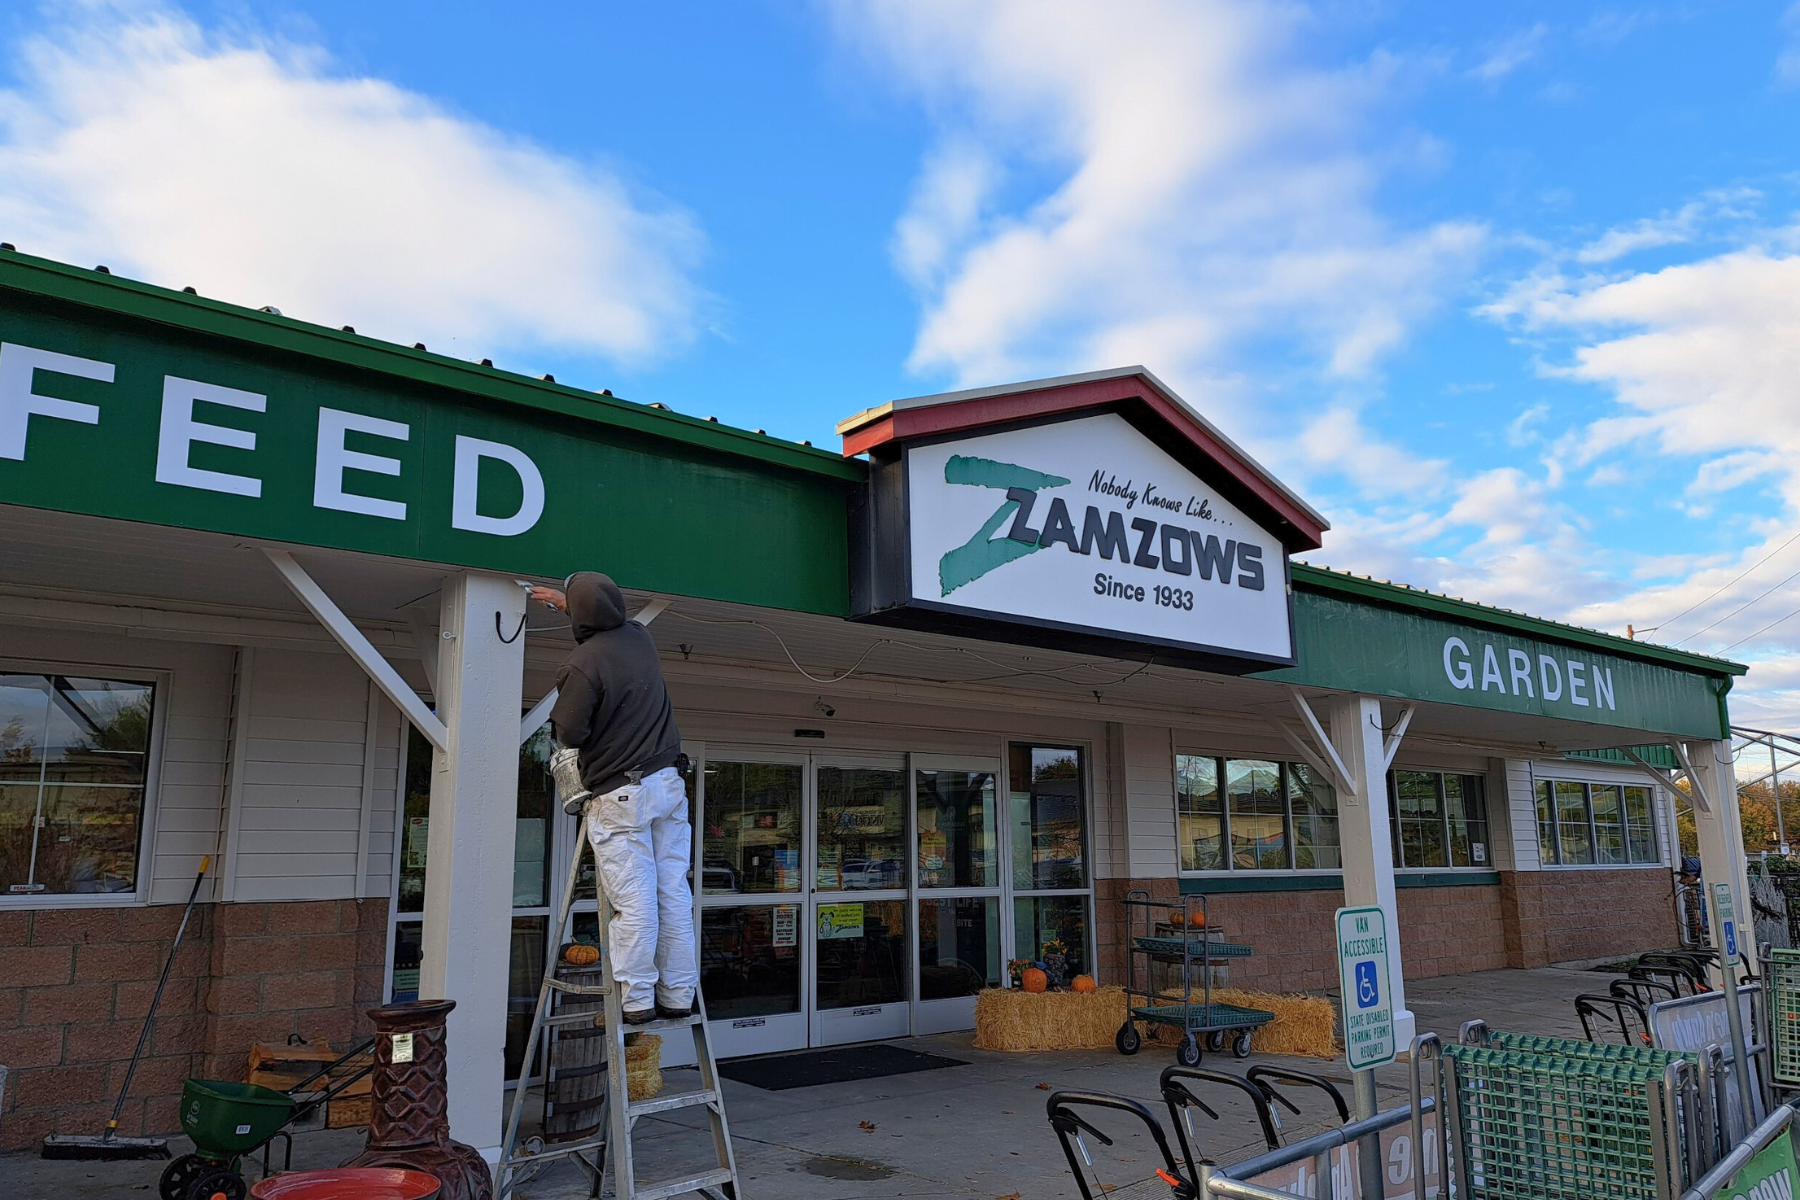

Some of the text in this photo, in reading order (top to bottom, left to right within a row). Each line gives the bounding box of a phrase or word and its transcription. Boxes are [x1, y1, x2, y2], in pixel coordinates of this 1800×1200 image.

[0, 341, 546, 537] FEED
[1088, 469, 1138, 510] Nobody
[1142, 483, 1182, 512] Knows
[1005, 486, 1265, 592] ZAMZOWS
[1093, 572, 1194, 611] Since 1933
[1443, 636, 1616, 711] GARDEN
[1355, 916, 1369, 933] VAN
[1344, 937, 1384, 958] ACCESSIBLE
[1350, 1009, 1389, 1029] STATE DISABLED
[1351, 1025, 1390, 1045] PARKING PERMIT
[1360, 1042, 1384, 1059] REQUIRED
